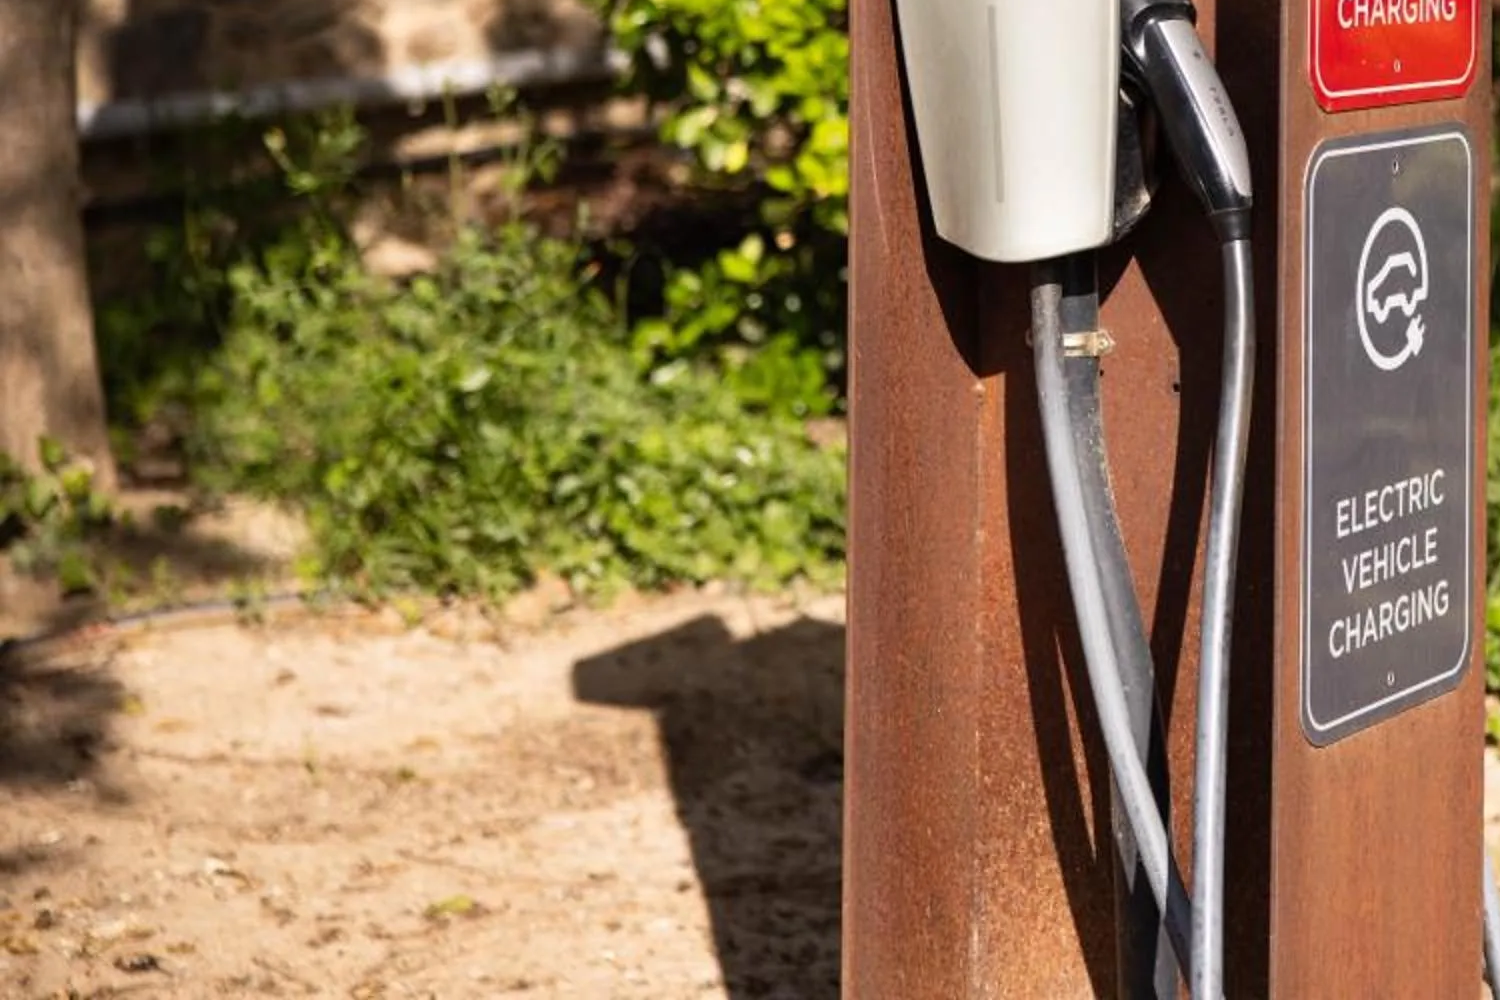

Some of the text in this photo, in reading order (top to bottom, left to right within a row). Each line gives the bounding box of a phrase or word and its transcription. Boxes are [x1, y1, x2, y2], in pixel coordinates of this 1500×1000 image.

[1336, 468, 1445, 539] ELECTRIC
[1342, 527, 1438, 594] VEHICLE
[1328, 580, 1449, 658] CHARGING
